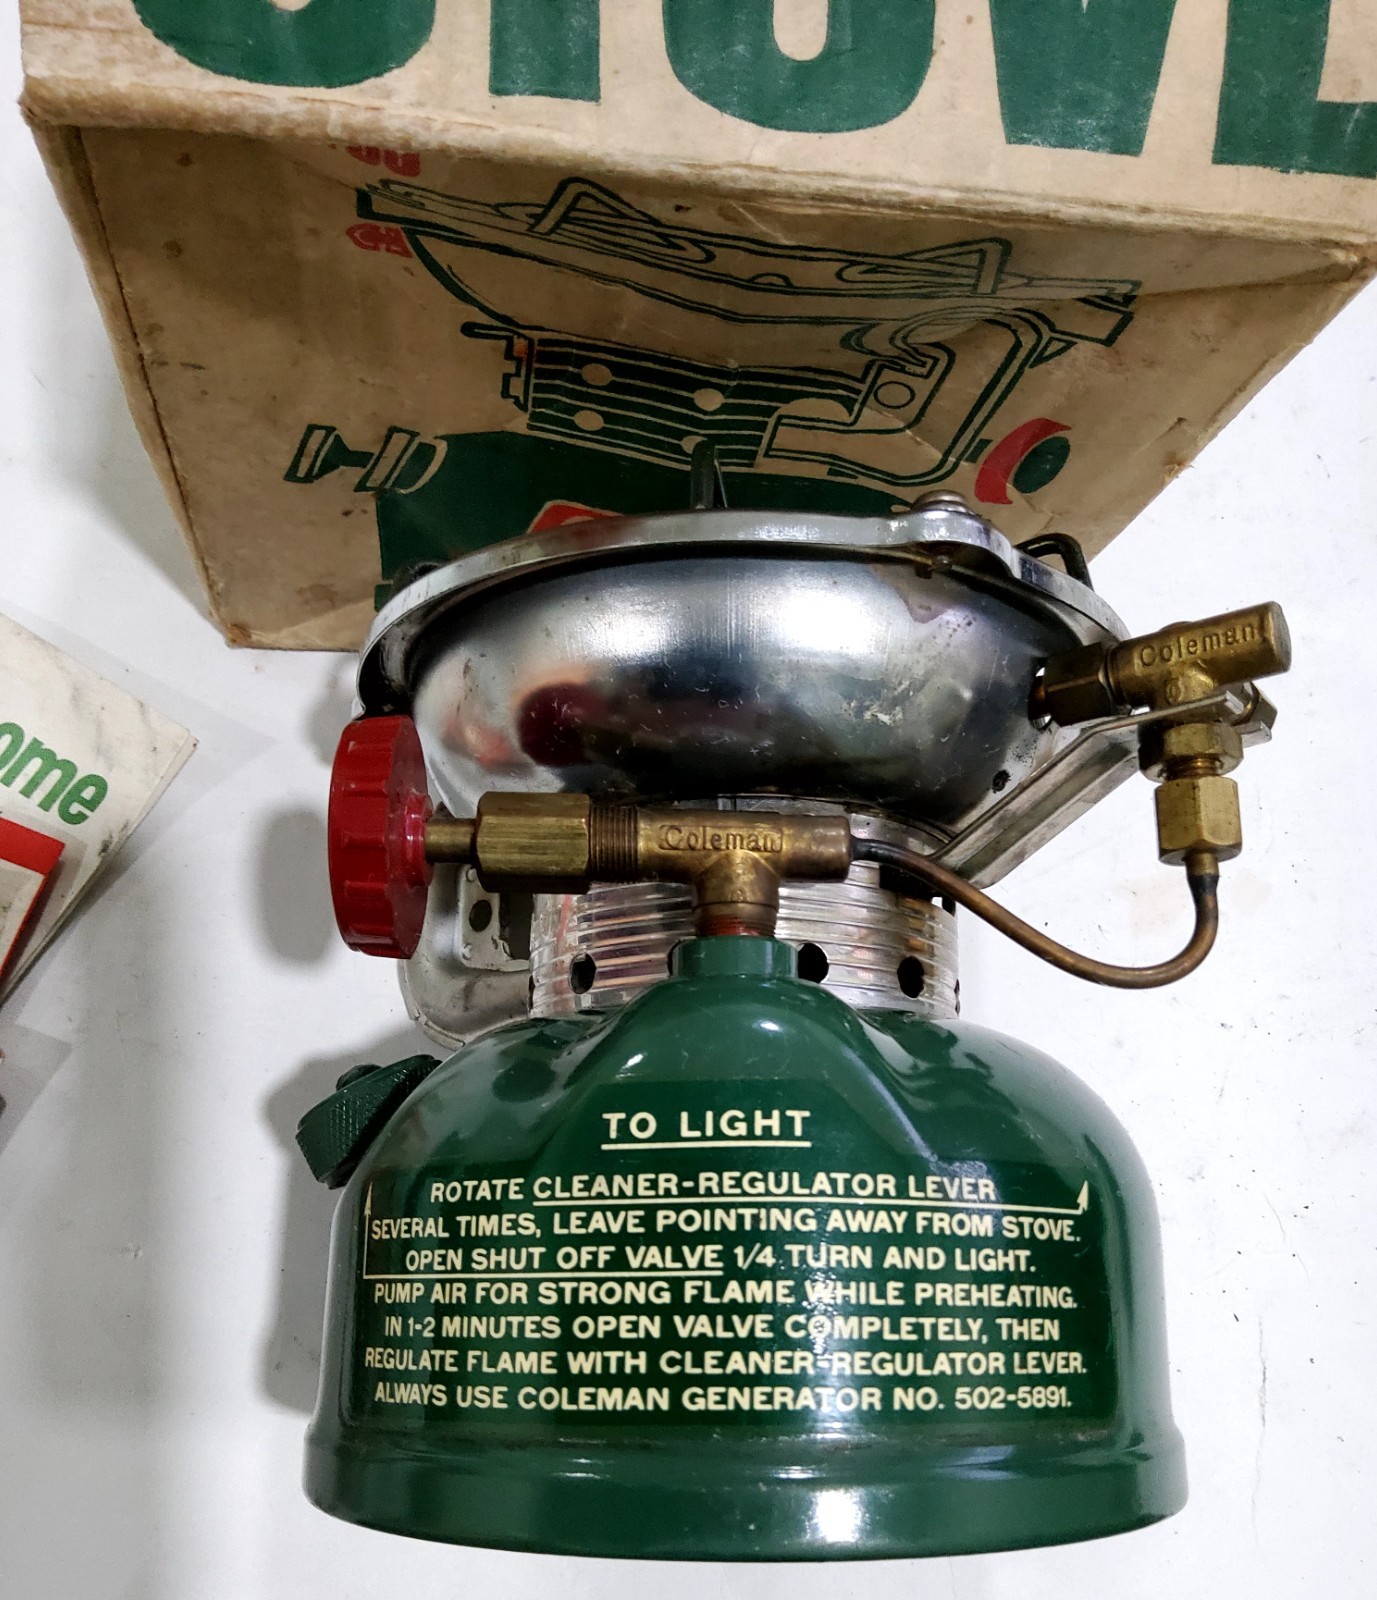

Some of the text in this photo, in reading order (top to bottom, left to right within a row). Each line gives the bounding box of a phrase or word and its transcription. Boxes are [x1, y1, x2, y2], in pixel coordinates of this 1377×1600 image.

[1139, 622, 1256, 668] Coleman
[664, 824, 777, 853] Coleman
[602, 1109, 811, 1139] TO LIGHT
[430, 1171, 997, 1203] ROTATE CLEANER-REGULATOR LEVER
[372, 1207, 1081, 1243] SEVERAL TIMES, LEAVE POINTING AWAY FROM STOVE.
[405, 1242, 1036, 1273] OPEN SHUT OFF VALVE 1/4 TURN AND LIGHT.
[374, 1280, 1078, 1309] PUMP AIR FOR STRONG FLAME WHILE PREHEATING.
[385, 1314, 1060, 1345] IN 1-2 MINUTES OPEN VALVE COMPLETELY, THEN
[364, 1347, 1087, 1376] REGULATE FLAME WITH CLEANER-REGULATOR LEVER.
[374, 1385, 1073, 1412] ALWAYS USE COLEMAN GENERATOR NO. 502-5891.
